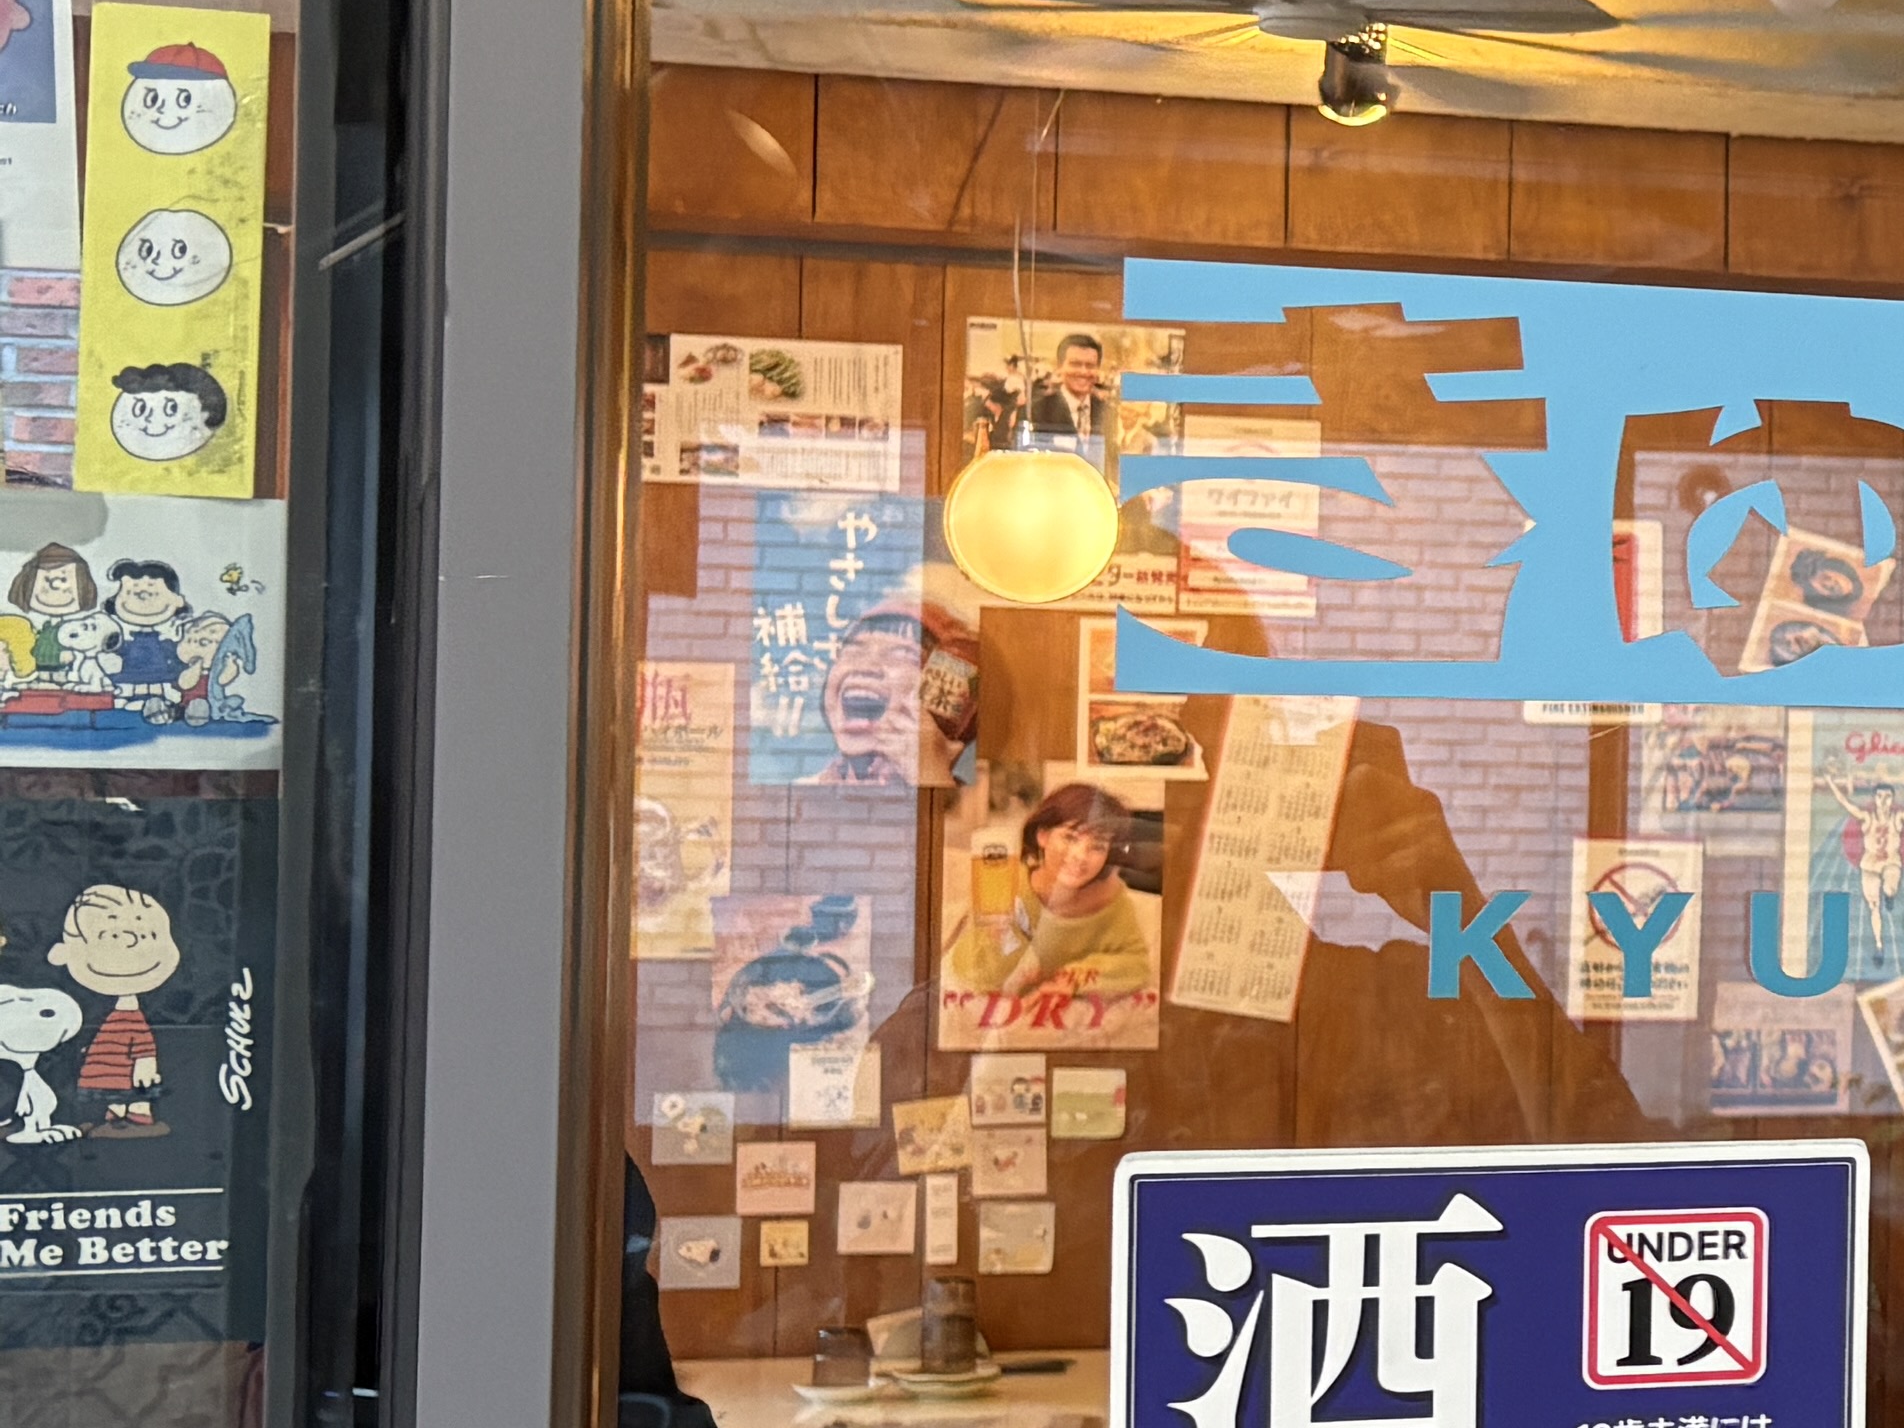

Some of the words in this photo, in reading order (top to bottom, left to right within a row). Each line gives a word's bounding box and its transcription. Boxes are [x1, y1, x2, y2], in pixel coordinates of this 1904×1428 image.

[0, 1200, 177, 1231] Friends
[0, 1238, 63, 1268] Me
[78, 1233, 230, 1265] Better
[1606, 1228, 1749, 1266] UNDER
[1615, 1272, 1737, 1370] 19
